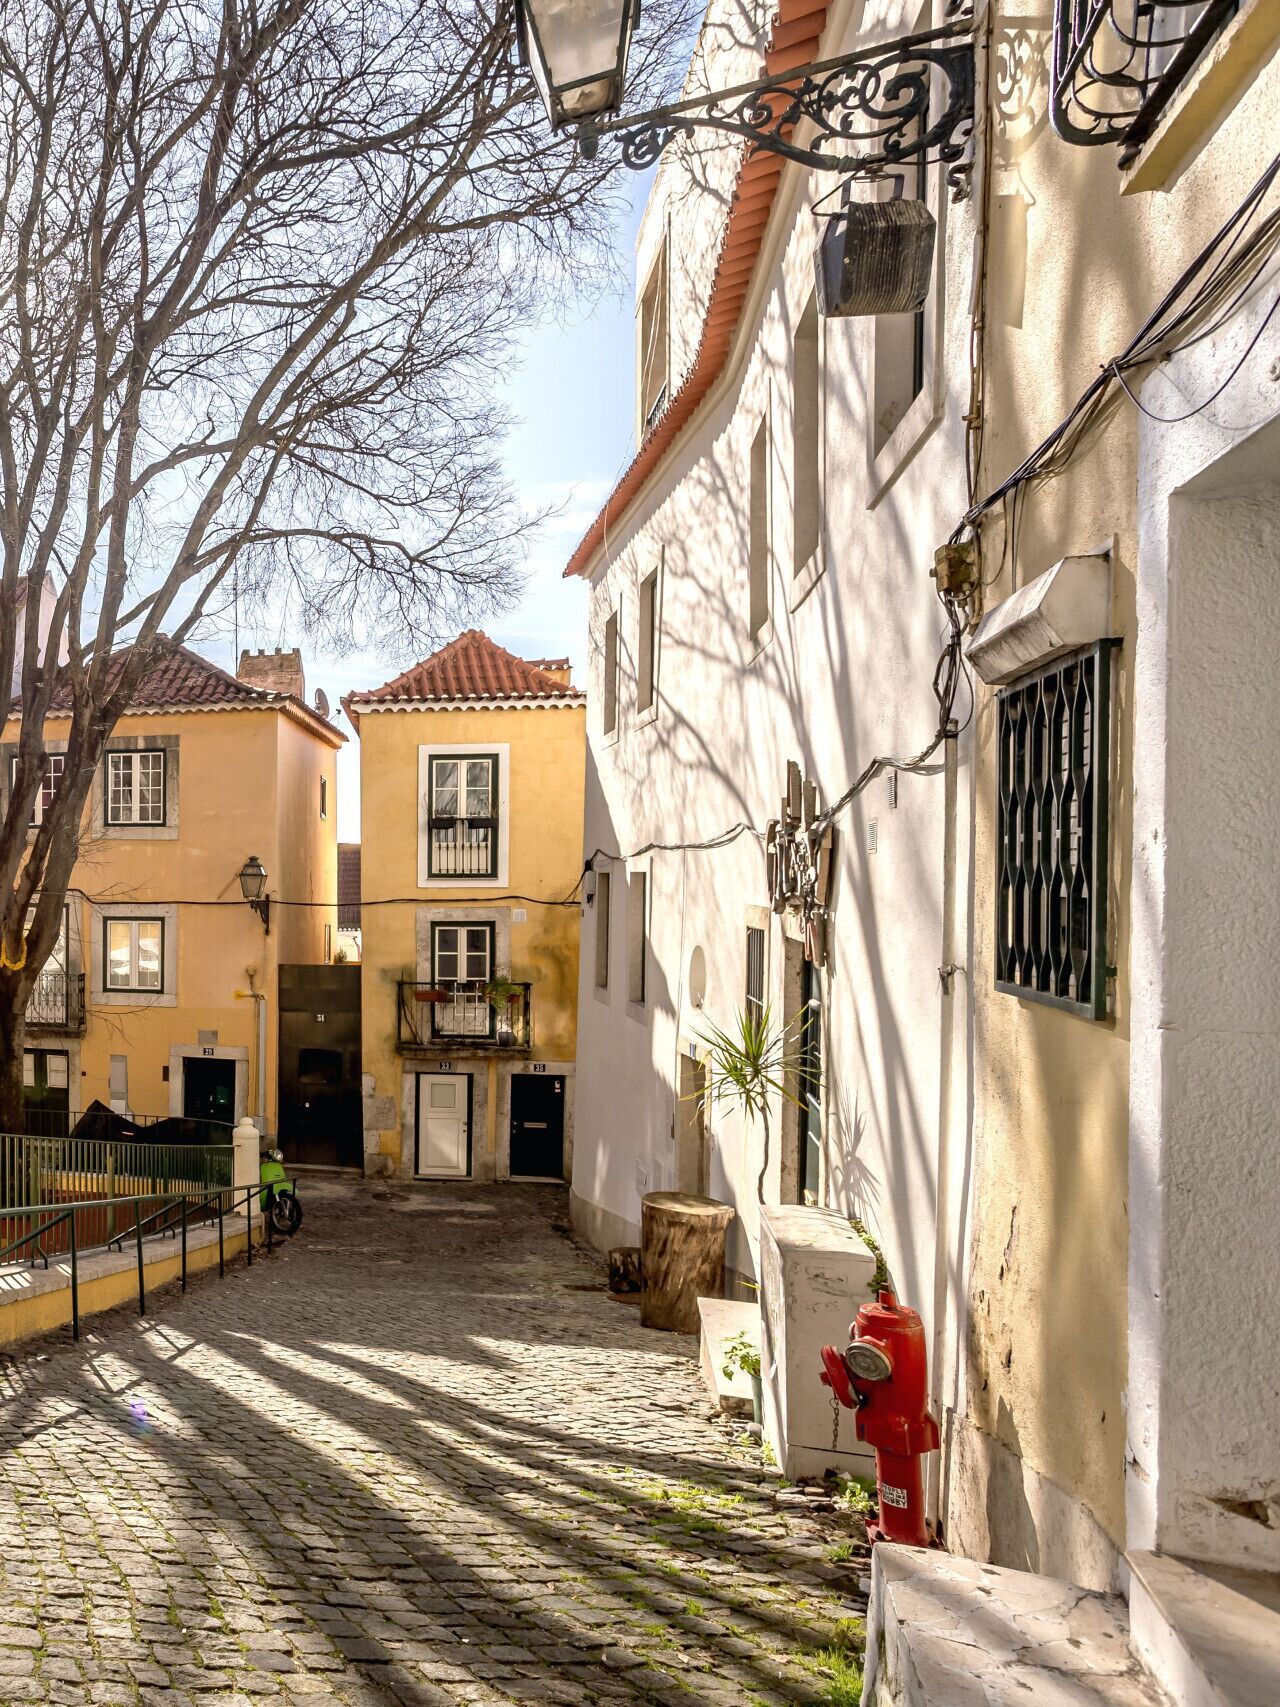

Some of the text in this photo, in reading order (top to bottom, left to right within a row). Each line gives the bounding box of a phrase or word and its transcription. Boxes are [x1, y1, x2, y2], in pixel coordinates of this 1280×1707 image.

[317, 1014, 325, 1022] 31
[441, 1062, 450, 1070] 33
[535, 1064, 544, 1072] 35
